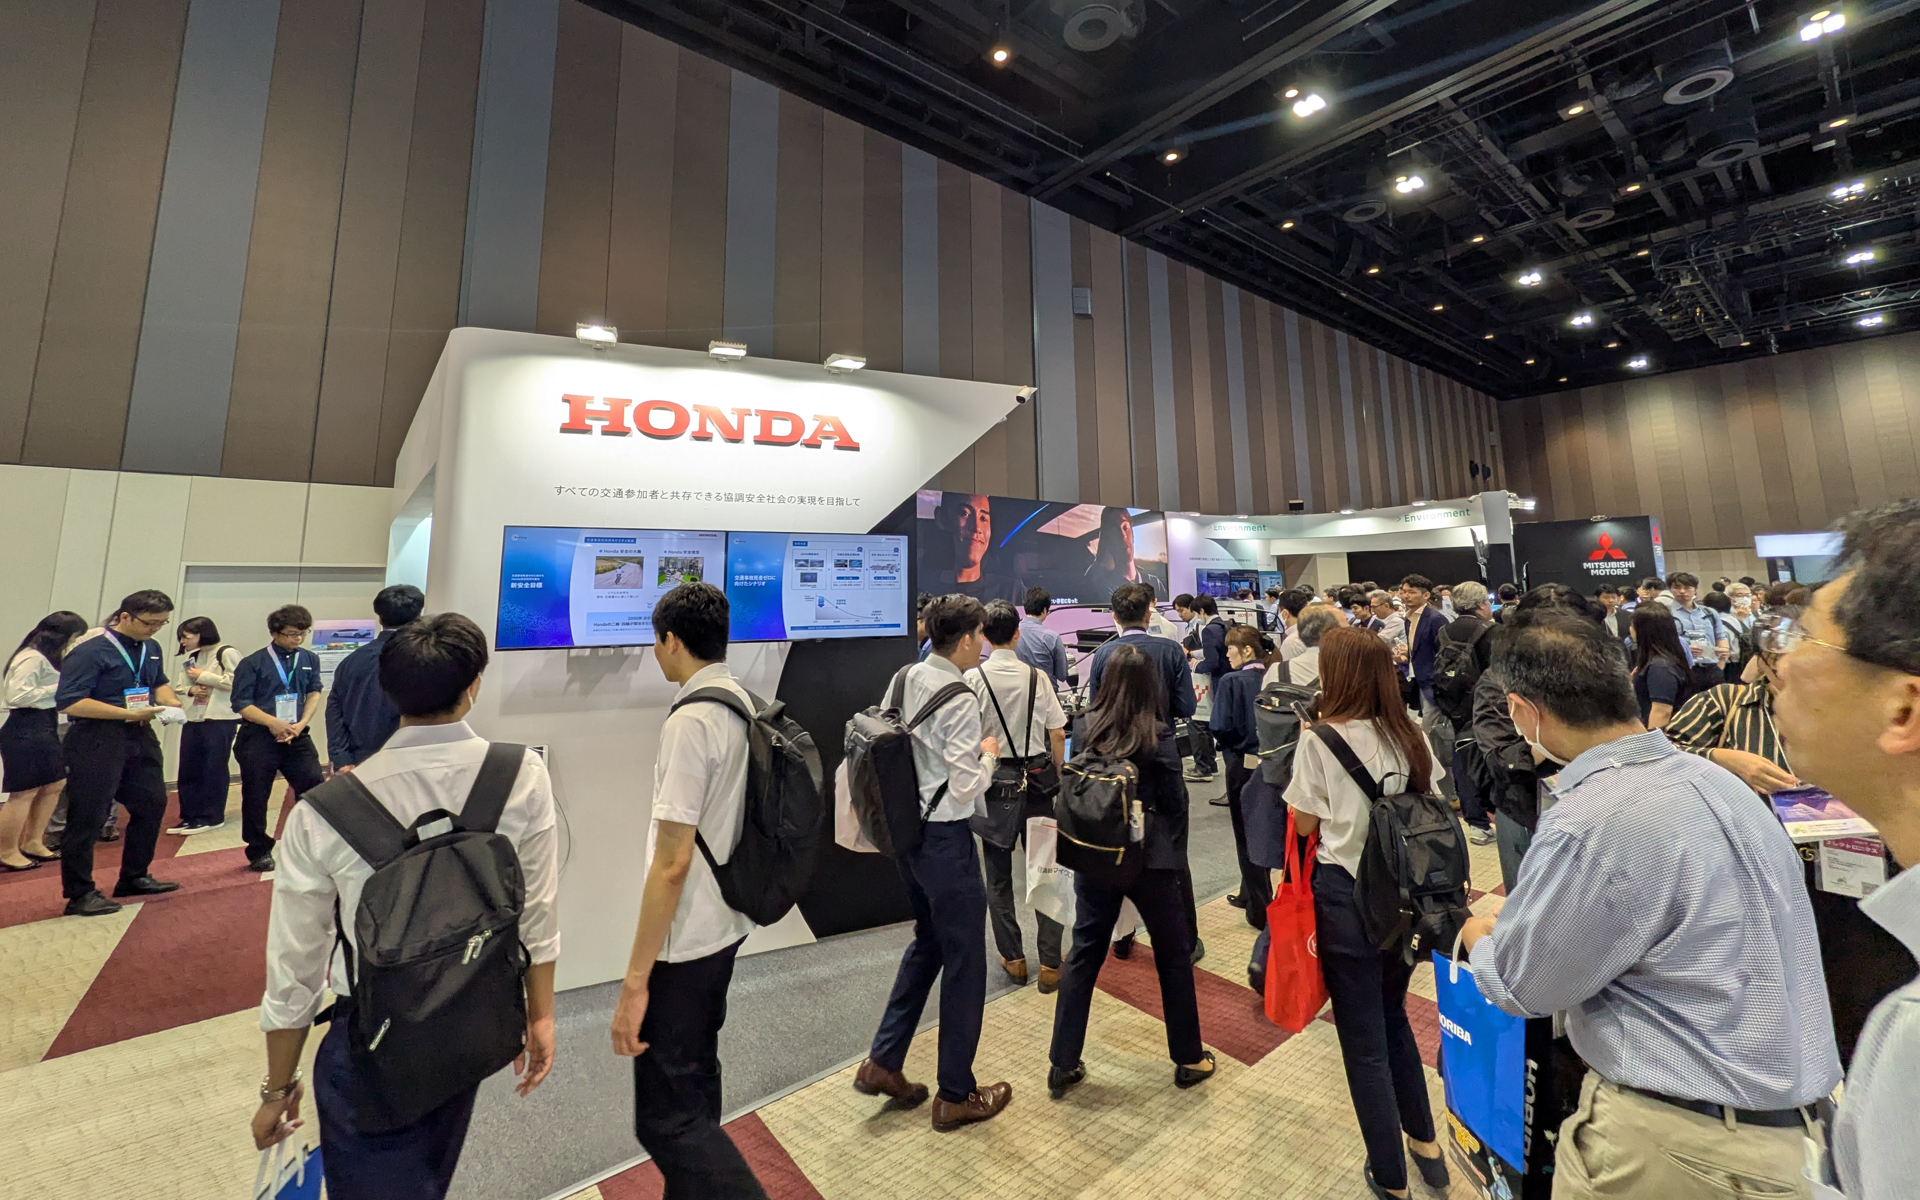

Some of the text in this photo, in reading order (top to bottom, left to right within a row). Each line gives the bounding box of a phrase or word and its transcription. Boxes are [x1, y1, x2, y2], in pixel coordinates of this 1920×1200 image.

[559, 393, 860, 452] HONDA
[554, 485, 861, 507] すべての交通参加者と共存できる協調安全社会の実現を目指して
[1404, 507, 1470, 522] Environment
[1583, 560, 1636, 569] MITSUBISHI
[1590, 568, 1630, 576] MOTORS
